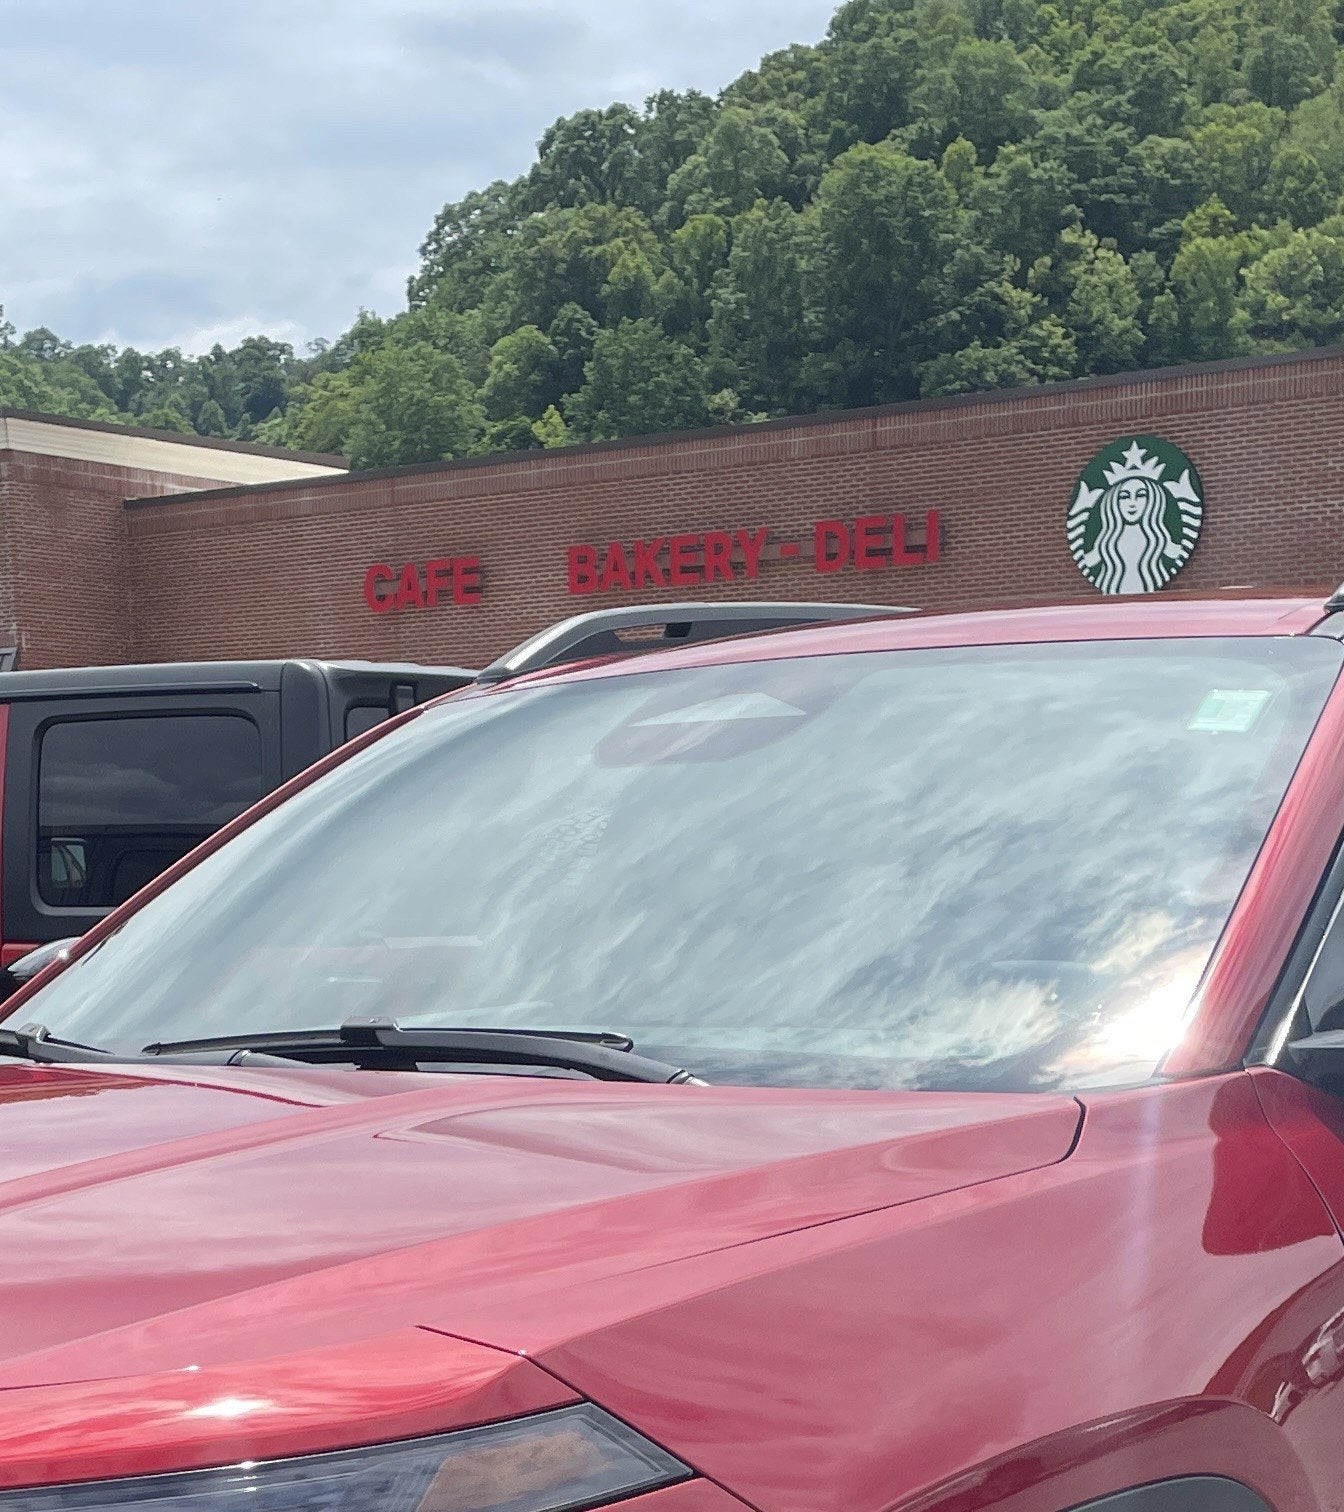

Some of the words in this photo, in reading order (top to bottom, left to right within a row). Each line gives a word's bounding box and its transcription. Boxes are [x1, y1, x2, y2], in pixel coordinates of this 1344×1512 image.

[364, 555, 481, 613] CAFE
[567, 527, 769, 595] BAKERY
[814, 508, 940, 573] DELI
